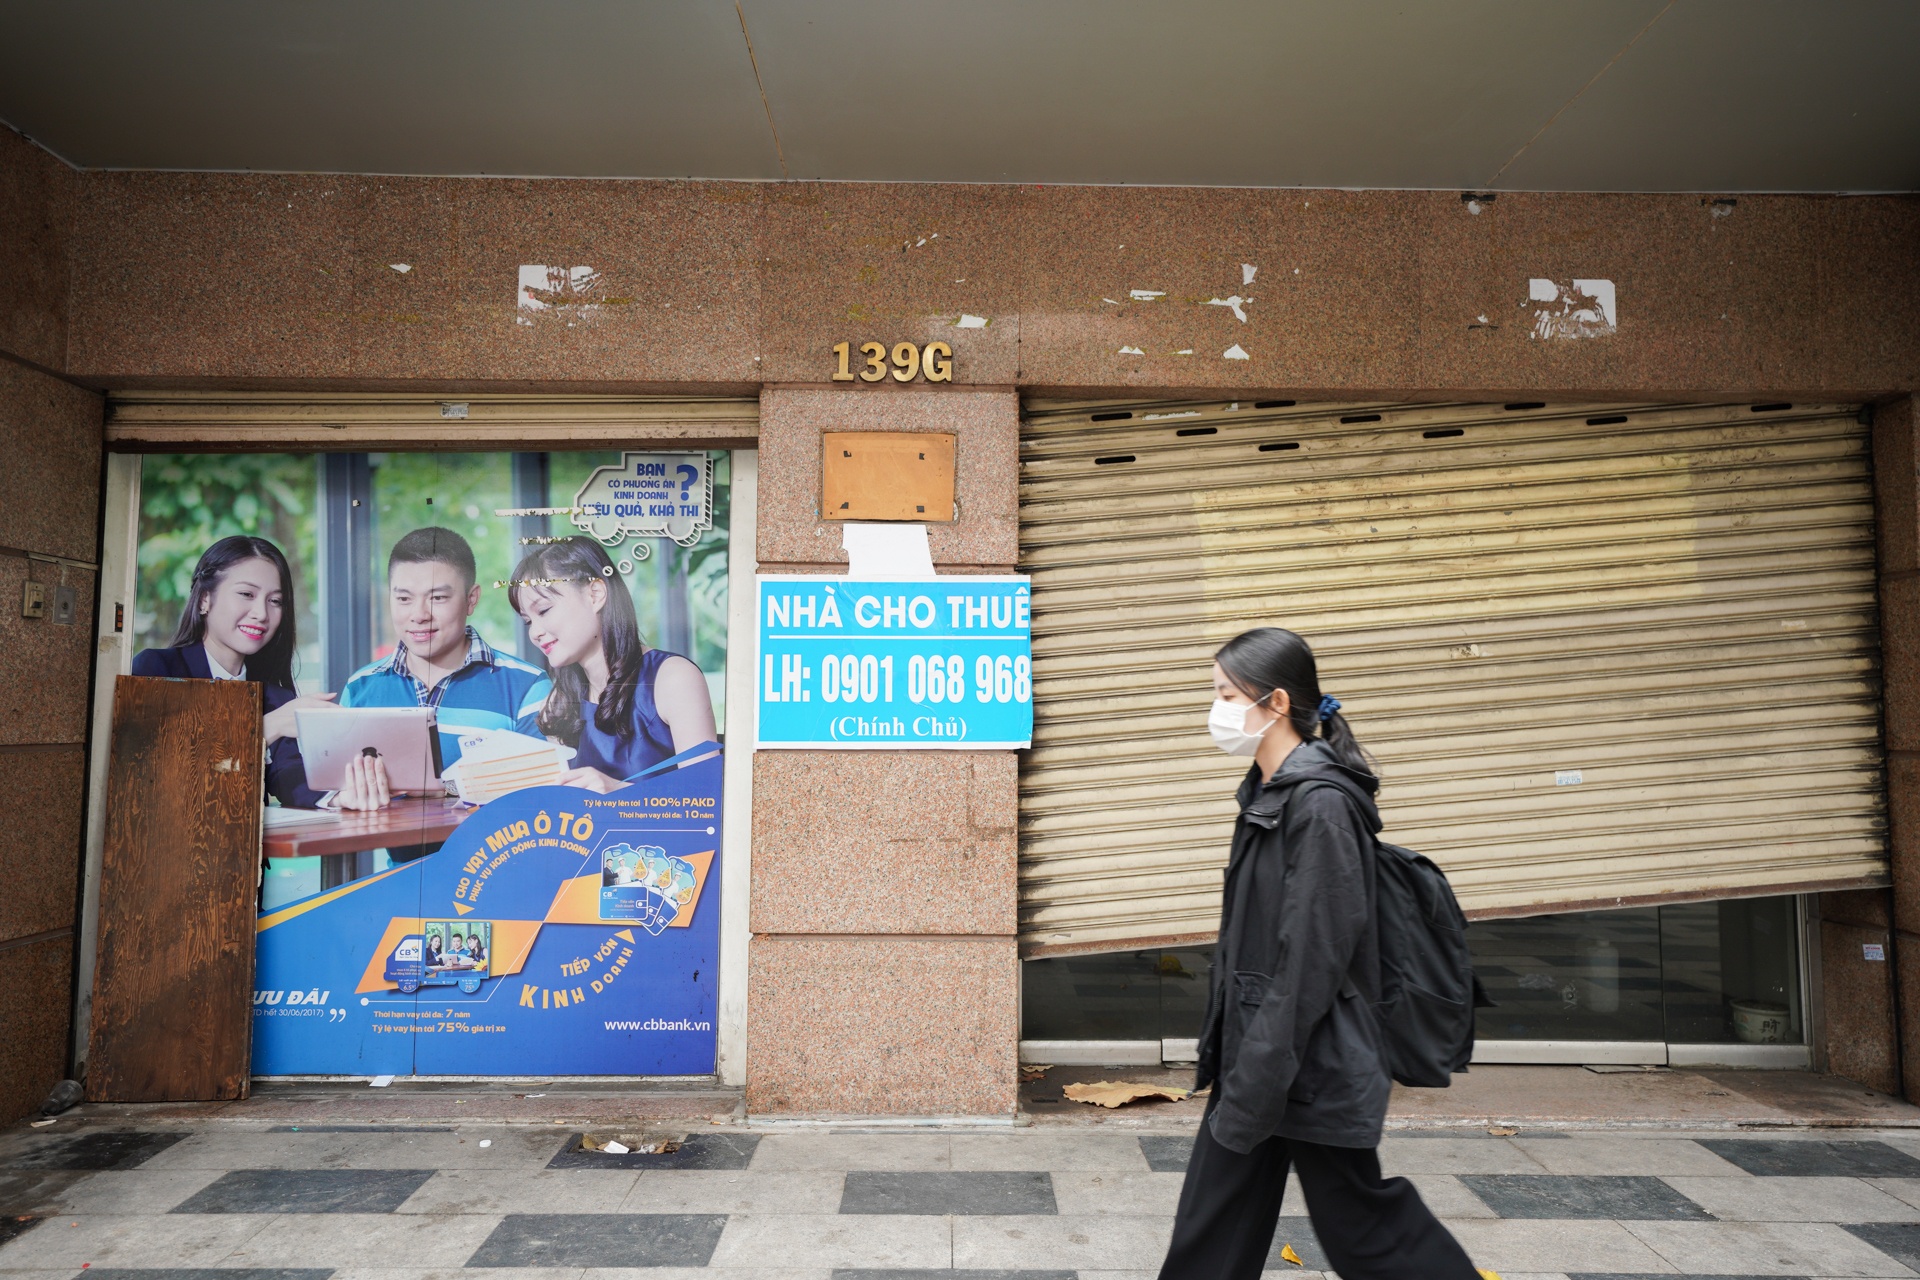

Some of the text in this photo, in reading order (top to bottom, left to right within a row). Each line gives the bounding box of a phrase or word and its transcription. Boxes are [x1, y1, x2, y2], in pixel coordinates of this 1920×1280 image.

[832, 341, 952, 382] 139G
[637, 463, 665, 479] BẠN
[608, 479, 621, 488] CÓ
[663, 478, 676, 489] ÁN
[614, 491, 668, 500] KINH DOANH
[583, 500, 699, 519] ỆU QUẢ, KHẢ THI
[767, 585, 1029, 628] NHÀ CHO THUÊ
[764, 654, 1031, 703] LH: 0901 068 968
[830, 716, 967, 741] (Chính Chủ)
[643, 797, 680, 807] 100%
[682, 797, 715, 807] PAKD
[648, 812, 661, 820] vay
[685, 810, 699, 819] 10
[455, 810, 594, 899] CHO VAY MUA Ô TÔ
[469, 838, 590, 902] PHỤC VỤ HOẠT ĐỘNG KINH DOANH
[560, 938, 618, 977] TIẾP VỐN
[519, 947, 633, 1009] KINH DOANH
[286, 988, 330, 1005] ĐÃI
[279, 1008, 324, 1017] 30/06/2017)
[445, 1009, 453, 1018] 7
[393, 1026, 408, 1034] vay
[437, 1022, 469, 1032] 75%
[605, 1018, 710, 1030] www.cbbank.vn
